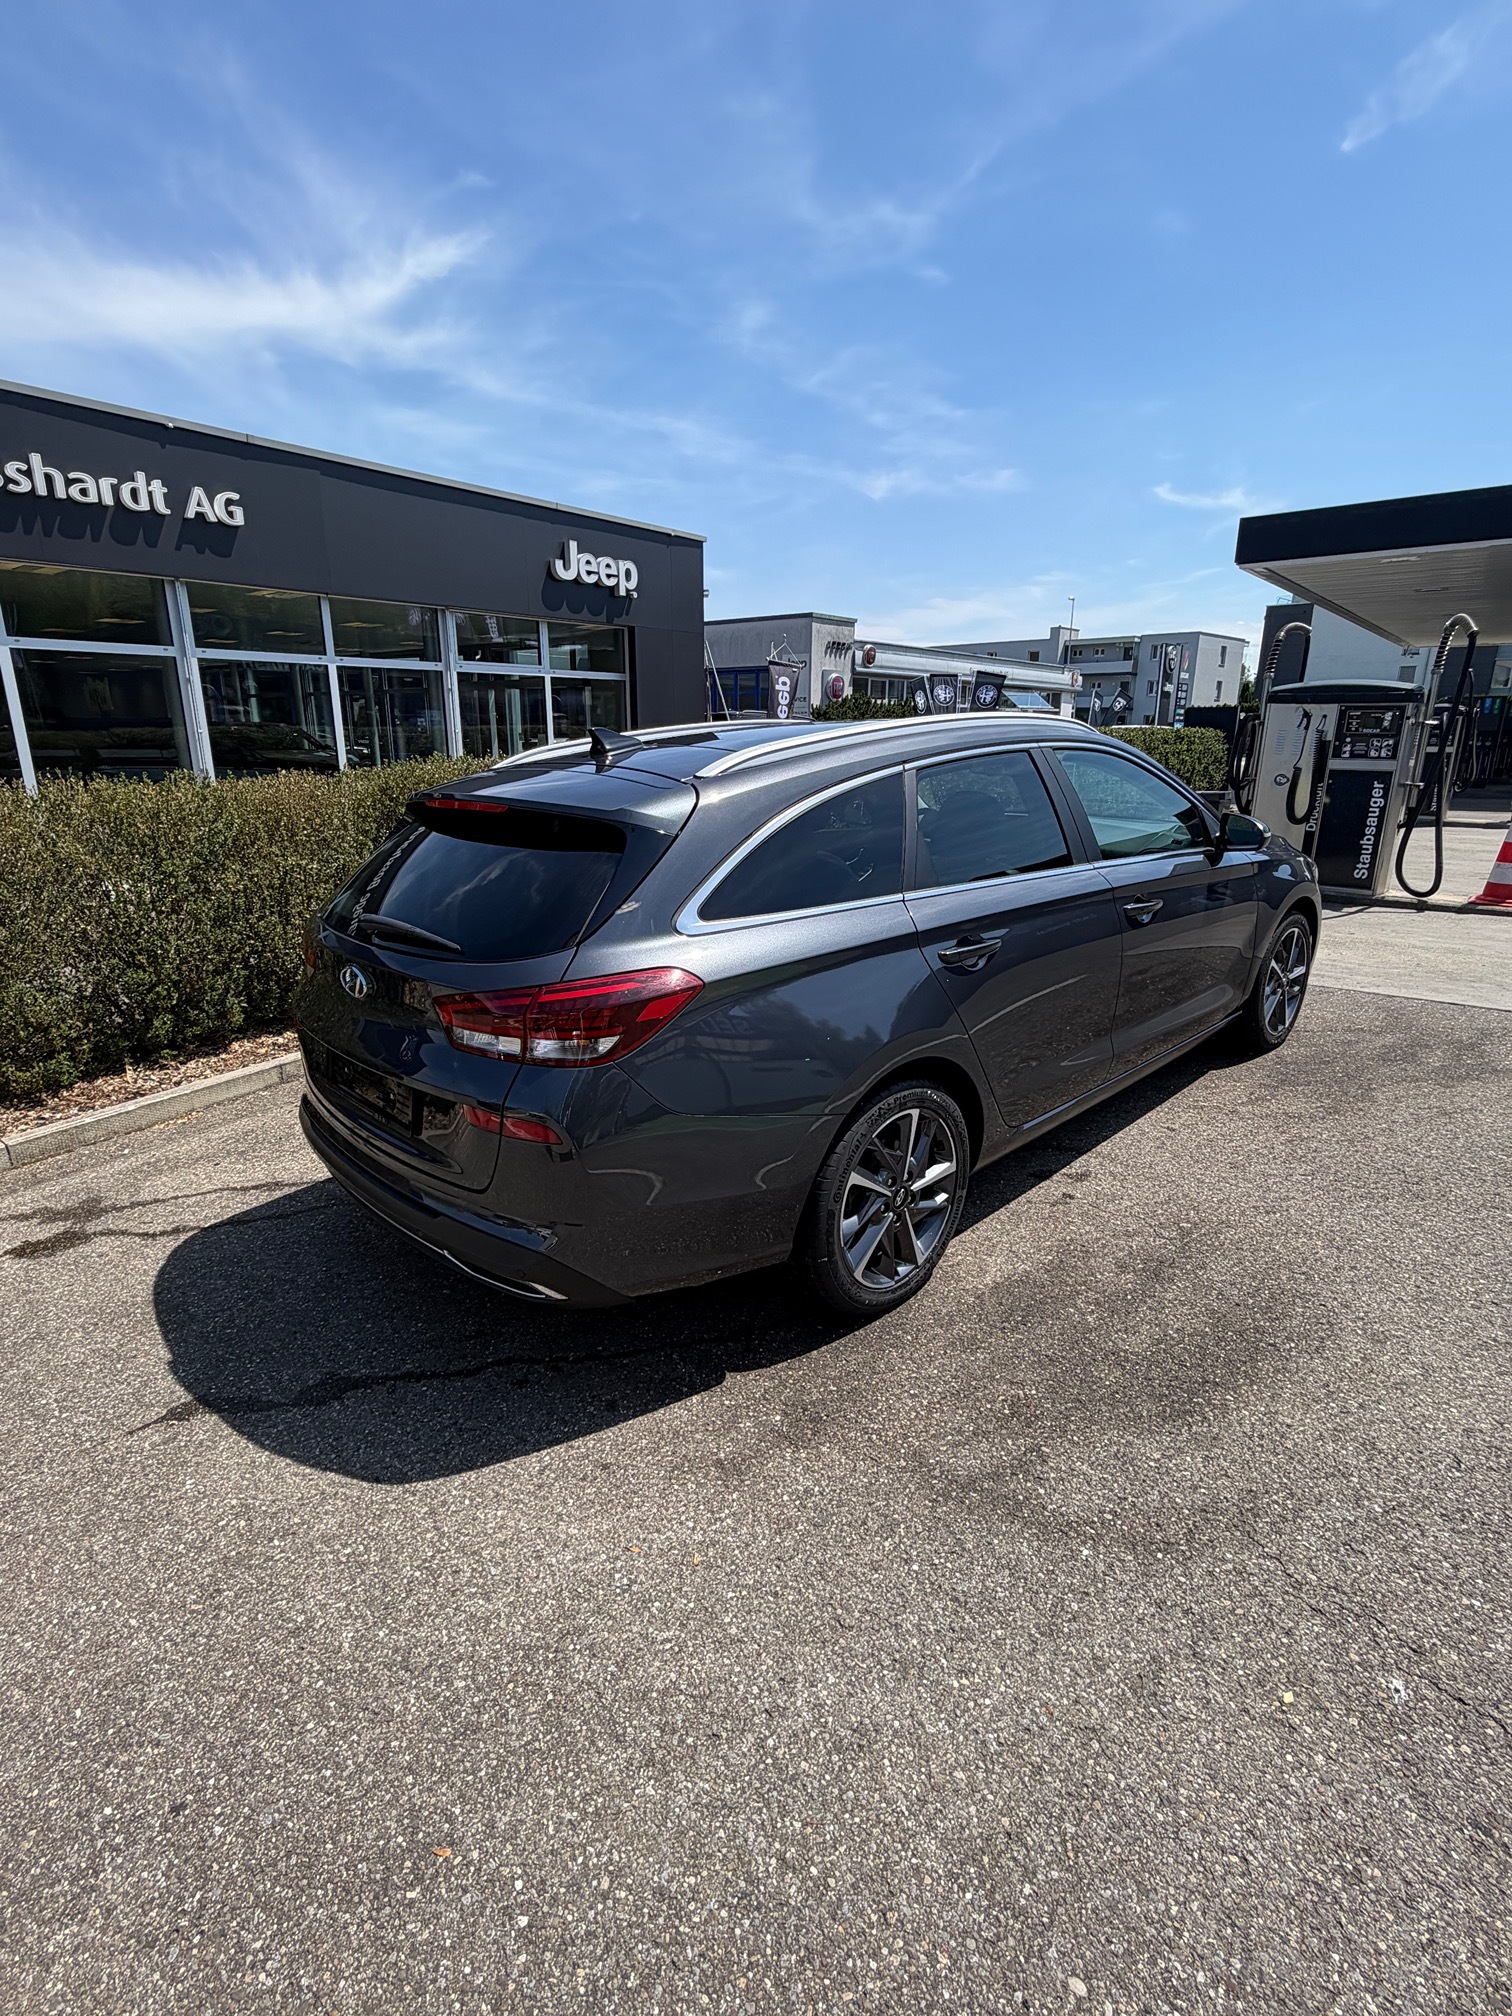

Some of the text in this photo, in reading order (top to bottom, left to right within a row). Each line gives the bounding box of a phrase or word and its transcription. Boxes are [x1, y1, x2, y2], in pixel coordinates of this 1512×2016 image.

[0, 452, 245, 526] shardt AG
[550, 539, 638, 598] Jeep
[1353, 780, 1385, 880] Staubsauger
